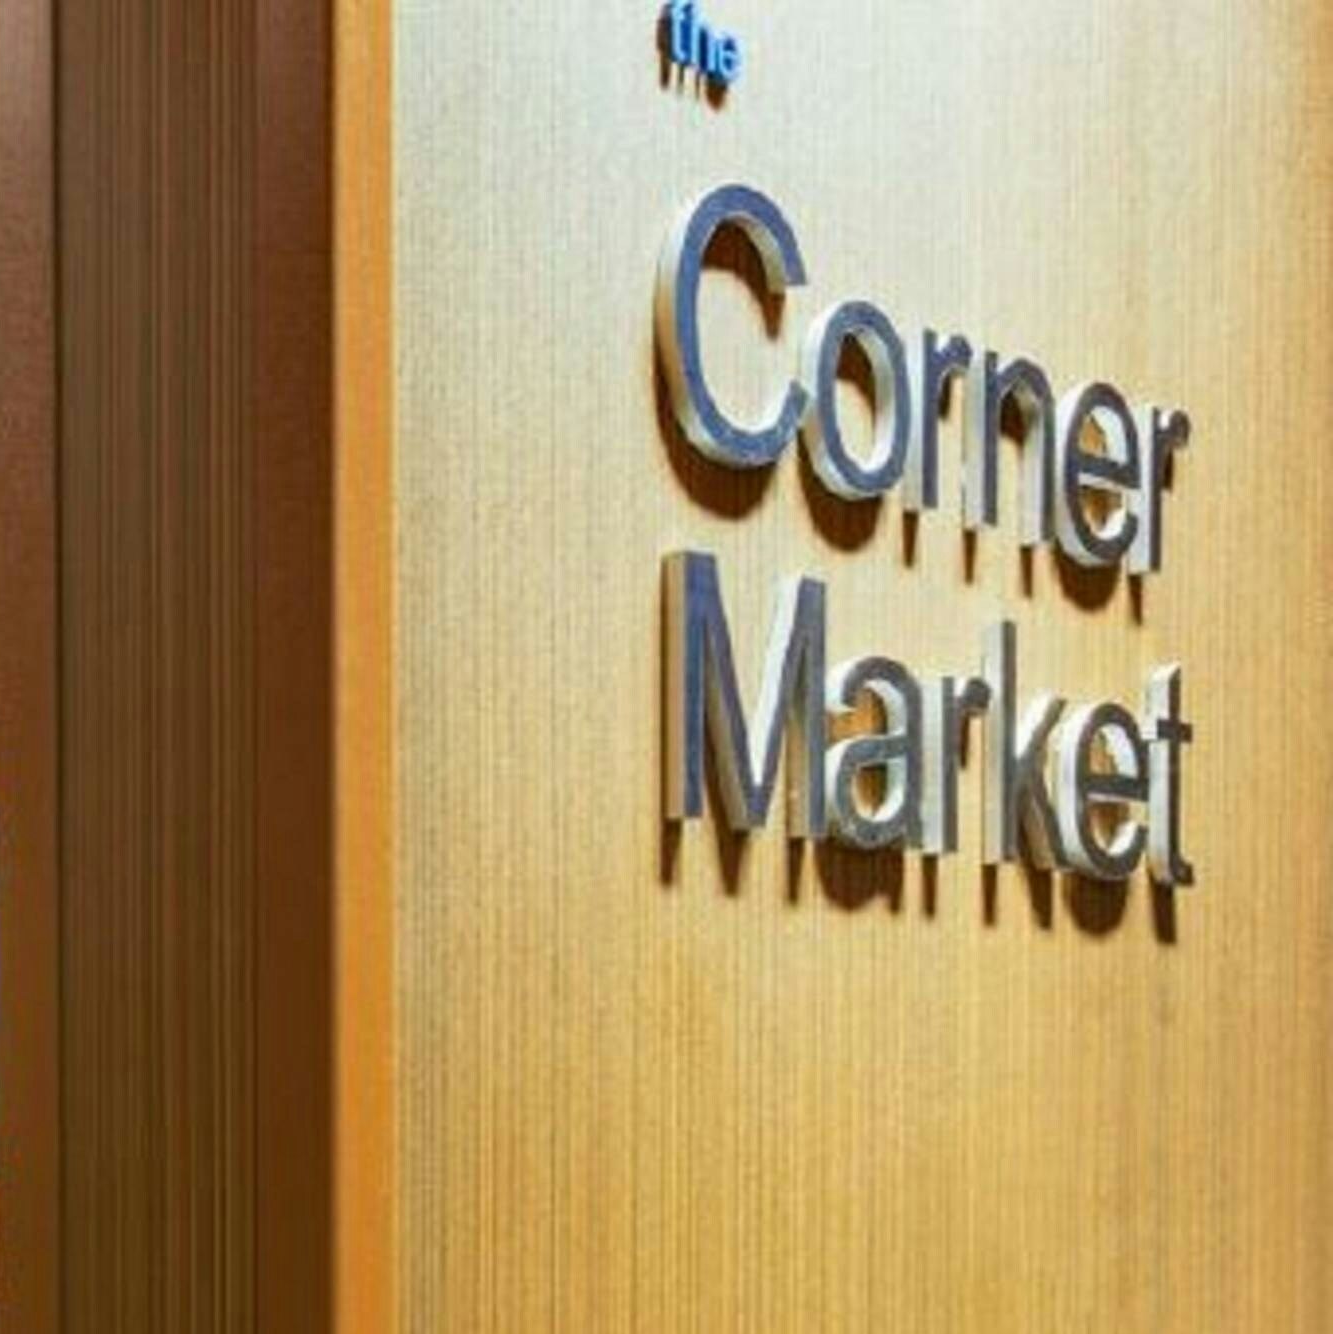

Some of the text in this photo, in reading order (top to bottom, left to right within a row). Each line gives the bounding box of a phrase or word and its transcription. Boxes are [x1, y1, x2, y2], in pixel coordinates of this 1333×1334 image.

[665, 0, 741, 84] the
[655, 183, 1190, 576] Corner
[661, 550, 1193, 888] Market
